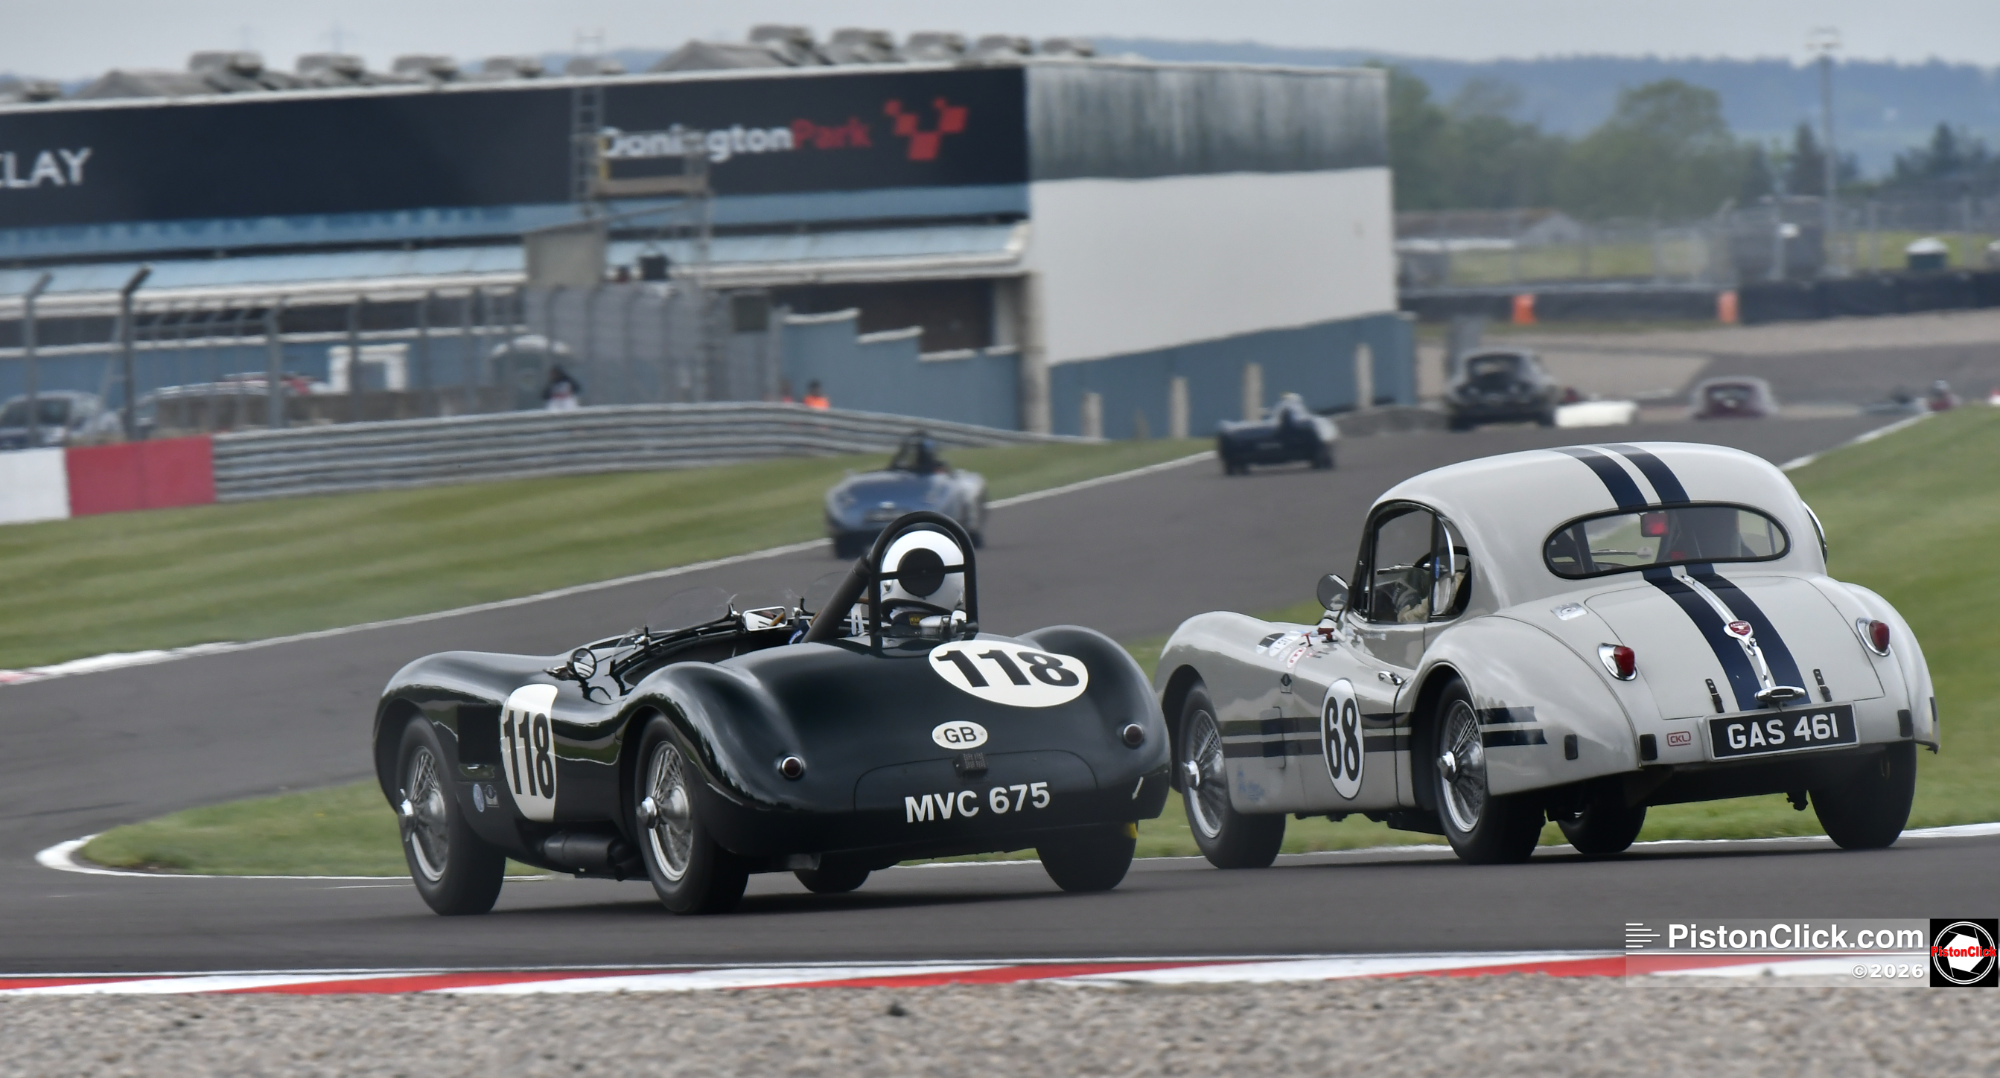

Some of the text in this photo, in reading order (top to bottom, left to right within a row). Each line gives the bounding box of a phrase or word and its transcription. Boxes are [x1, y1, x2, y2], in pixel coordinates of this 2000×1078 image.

[0, 147, 92, 188] LAY
[934, 649, 1079, 687] 118
[943, 726, 977, 743] GB
[1325, 696, 1360, 781] 68
[1669, 734, 1691, 744] CKL
[1727, 712, 1839, 750] GAS 461
[503, 710, 555, 800] 118
[904, 781, 1051, 823] MVC 675
